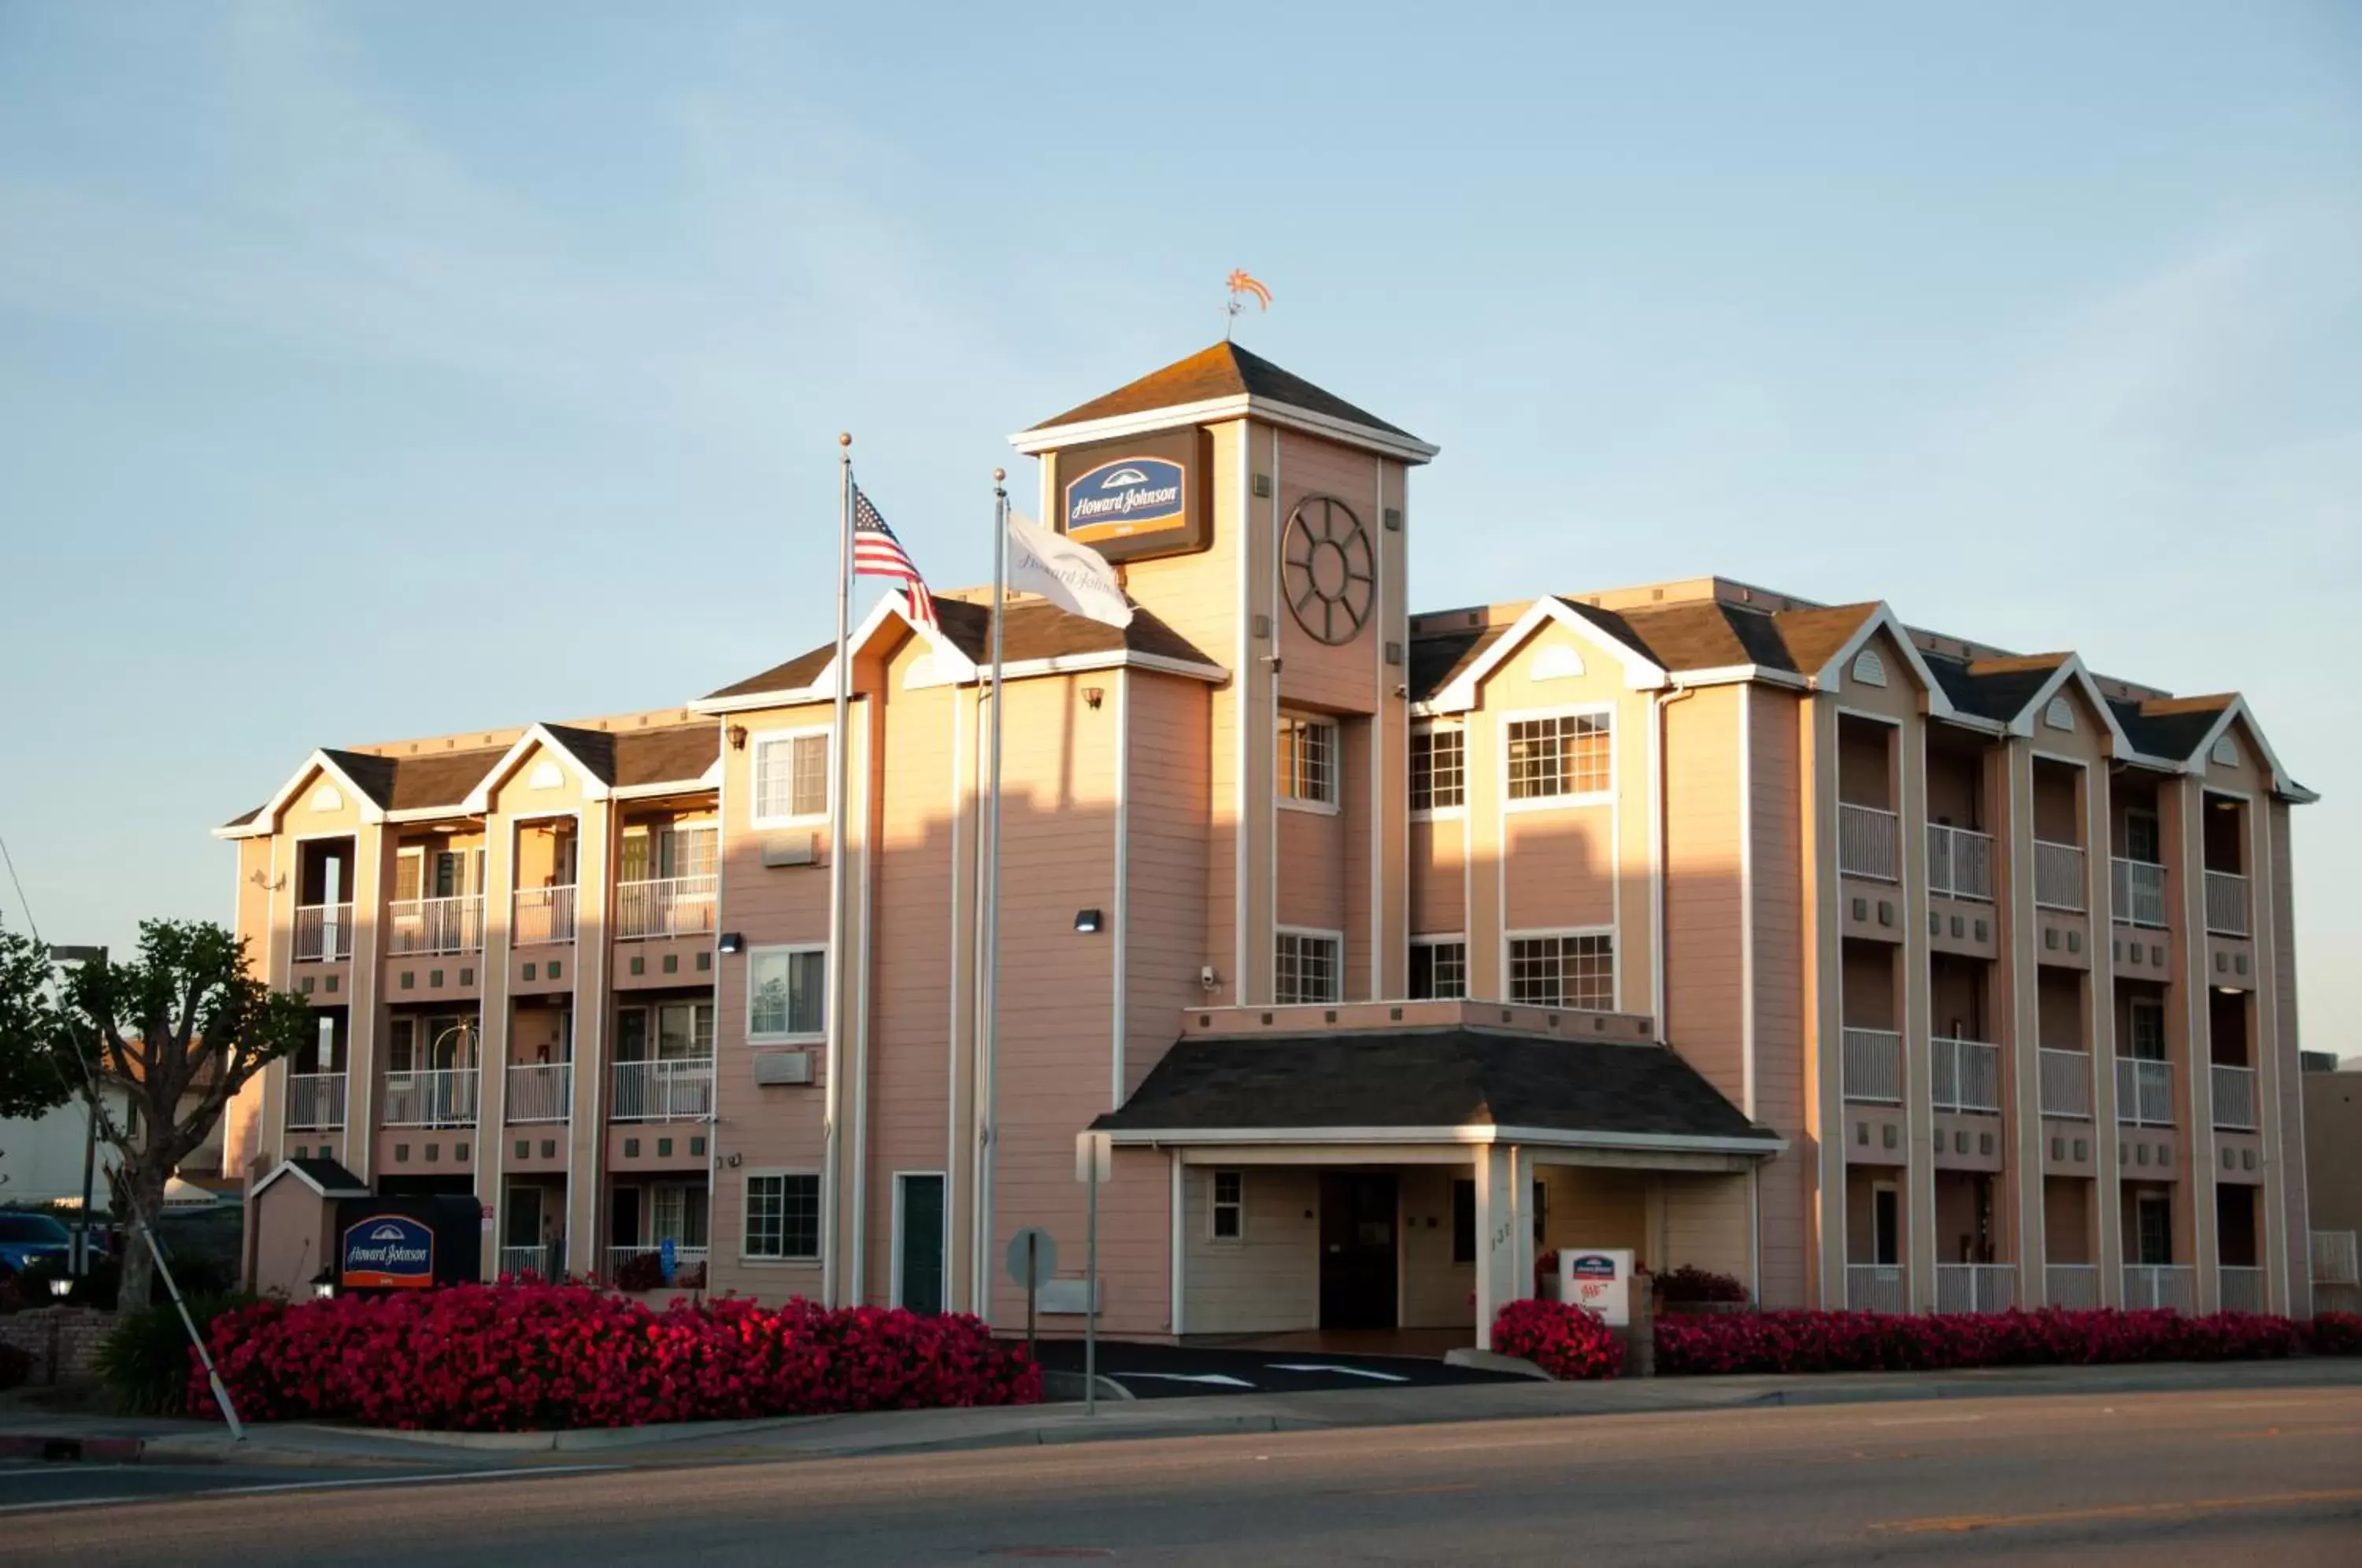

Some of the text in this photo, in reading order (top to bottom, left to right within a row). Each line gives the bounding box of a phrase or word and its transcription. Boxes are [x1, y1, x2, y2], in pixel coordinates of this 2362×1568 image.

[1072, 487, 1179, 519] Howard Johnson
[348, 1243, 428, 1266] Howard Johnson
